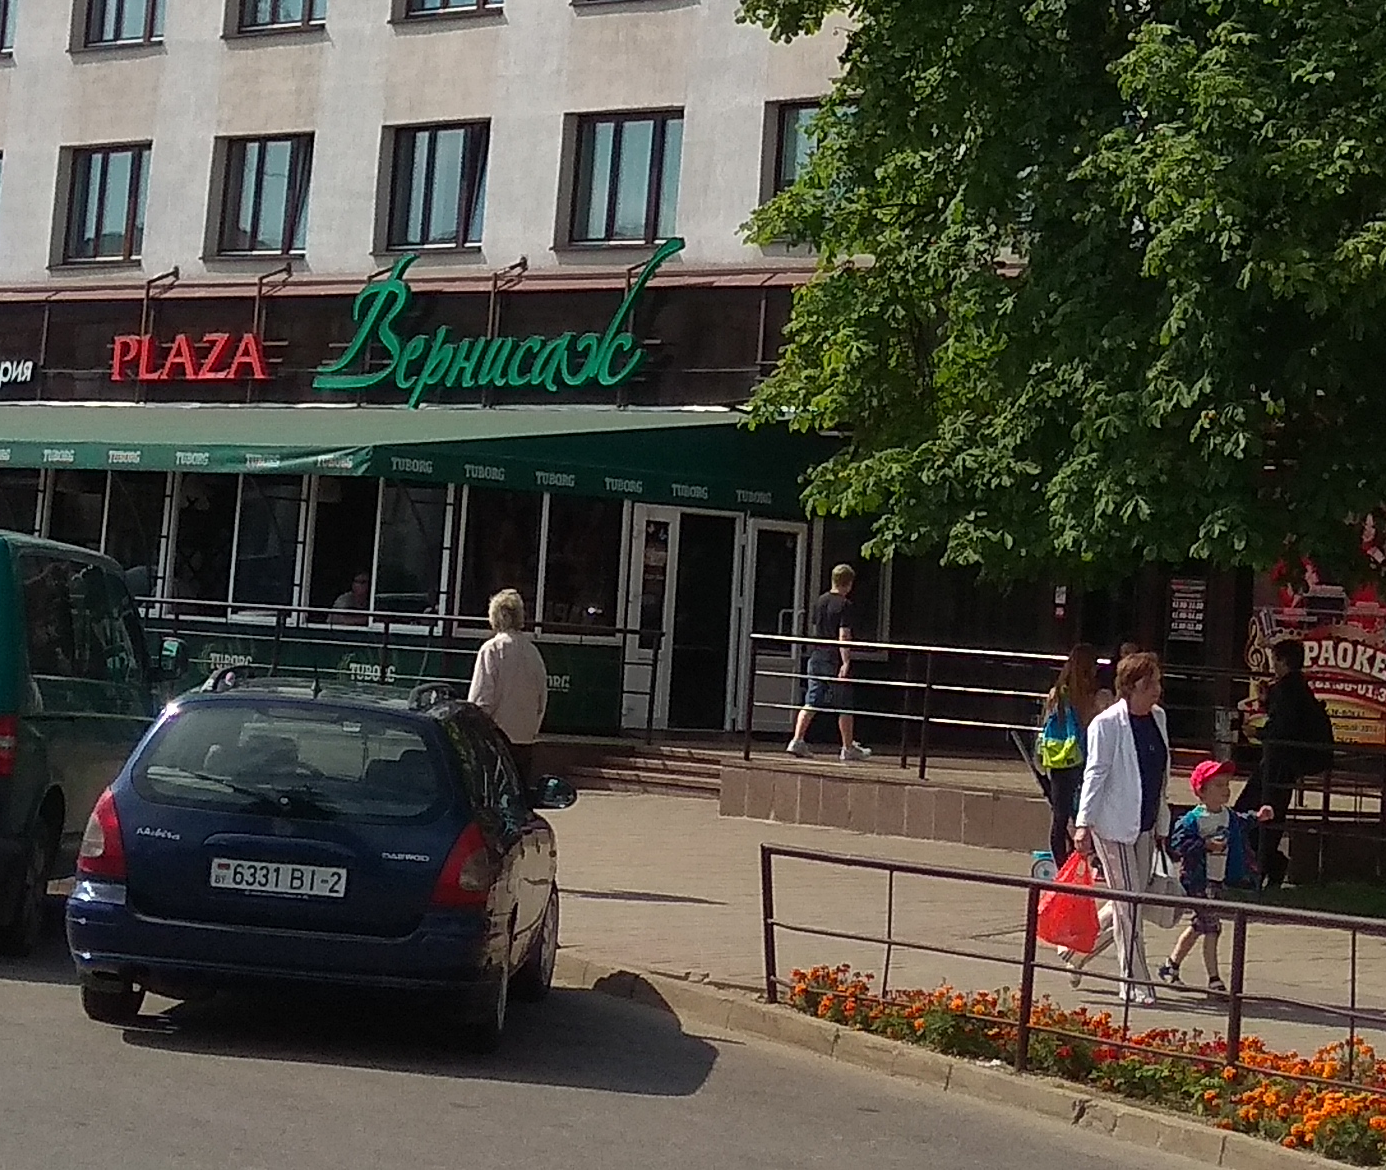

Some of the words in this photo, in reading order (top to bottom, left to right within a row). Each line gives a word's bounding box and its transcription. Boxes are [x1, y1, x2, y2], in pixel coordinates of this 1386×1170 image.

[311, 235, 687, 411] Вернисаж
[110, 330, 271, 382] PLAZA
[175, 451, 210, 466] TUBORG
[391, 457, 433, 474] TUBORG
[464, 463, 505, 481] TUBORG
[535, 471, 575, 487] TUBORG
[605, 477, 643, 494] TUBORG
[671, 483, 709, 500] TUBORG
[736, 489, 772, 505] TUBORG
[232, 863, 281, 888] 6331
